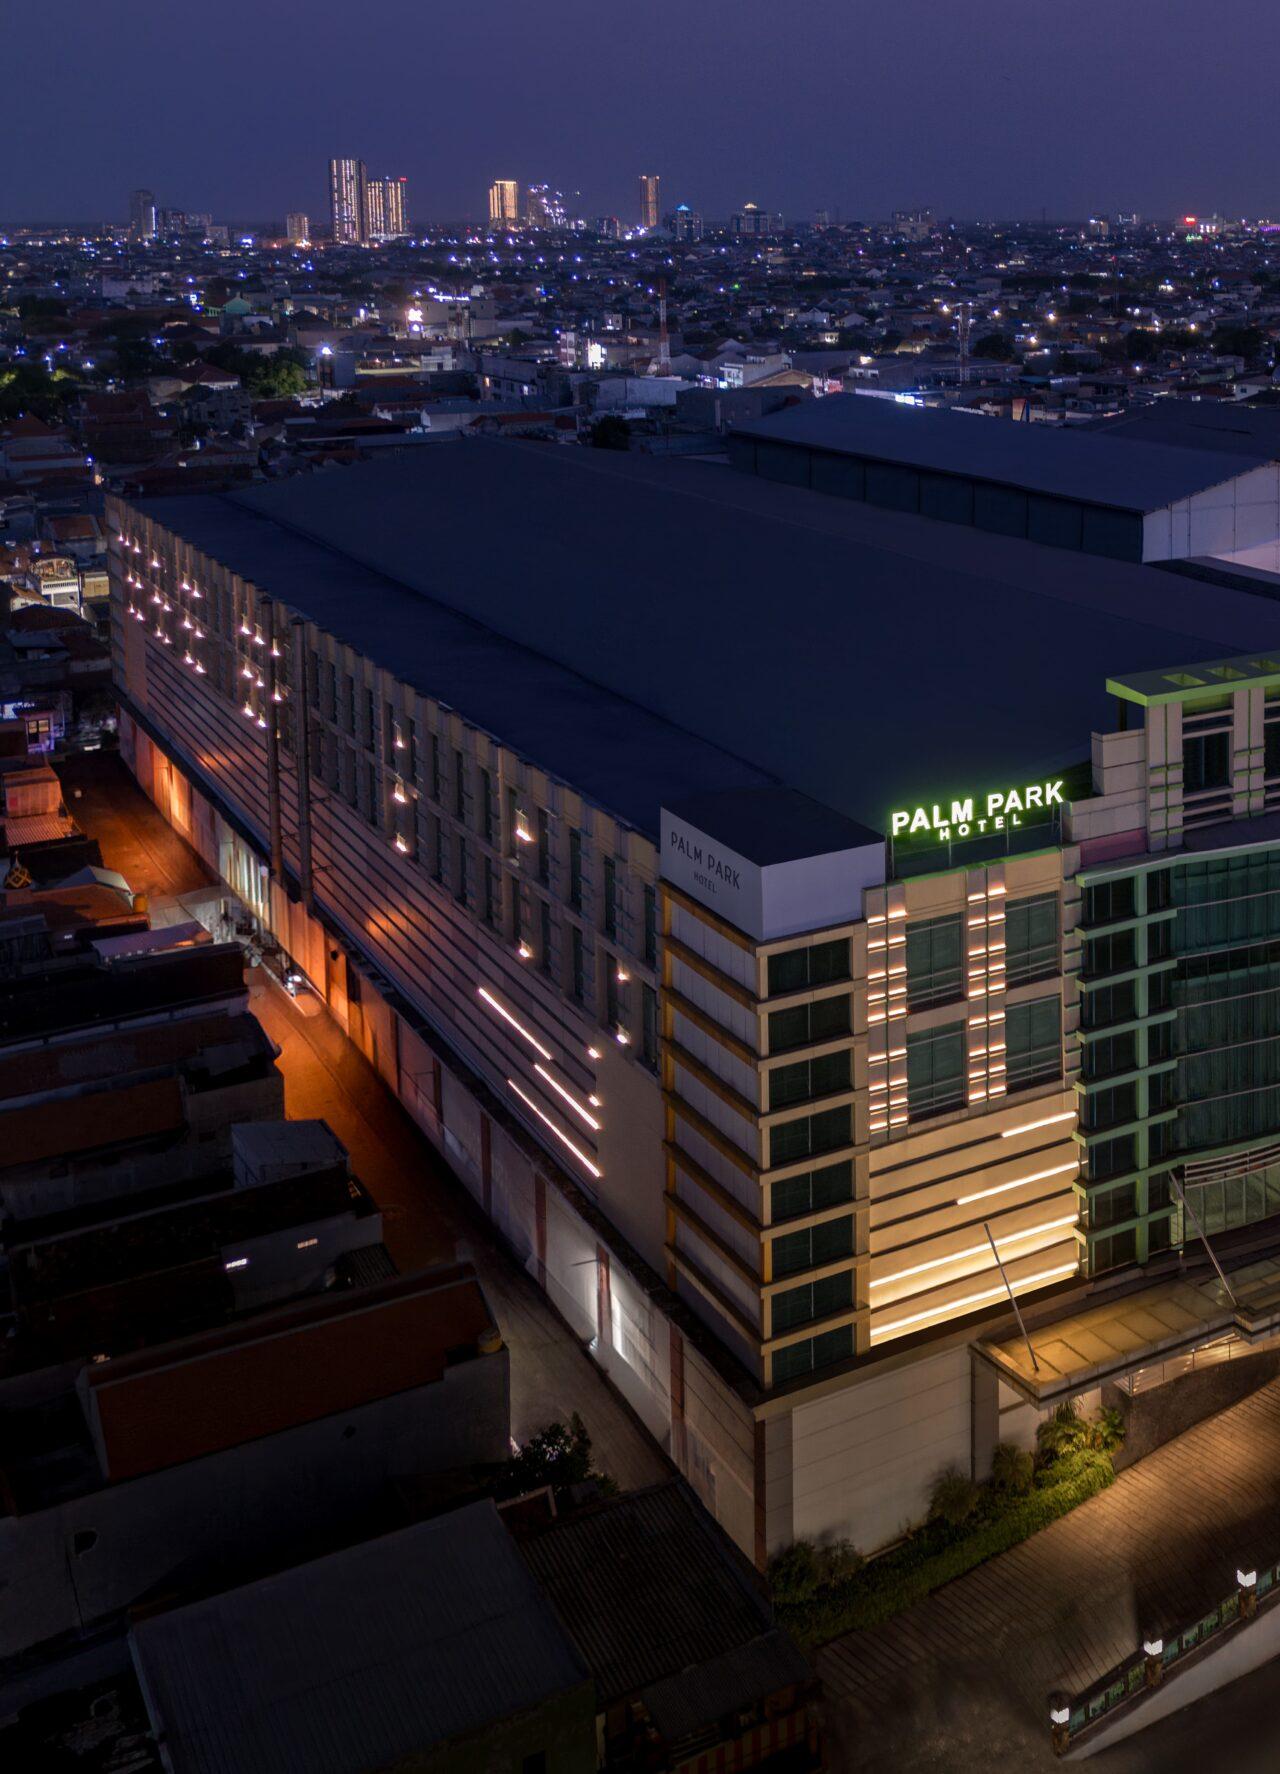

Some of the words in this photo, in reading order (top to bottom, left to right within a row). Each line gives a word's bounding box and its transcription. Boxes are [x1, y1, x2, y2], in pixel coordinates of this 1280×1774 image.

[892, 798, 974, 836] PALM
[987, 780, 1064, 817] PARK
[939, 813, 1022, 841] HOTEL
[671, 831, 703, 865] PALM
[707, 853, 741, 890] PARK
[693, 871, 718, 894] HOTEL
